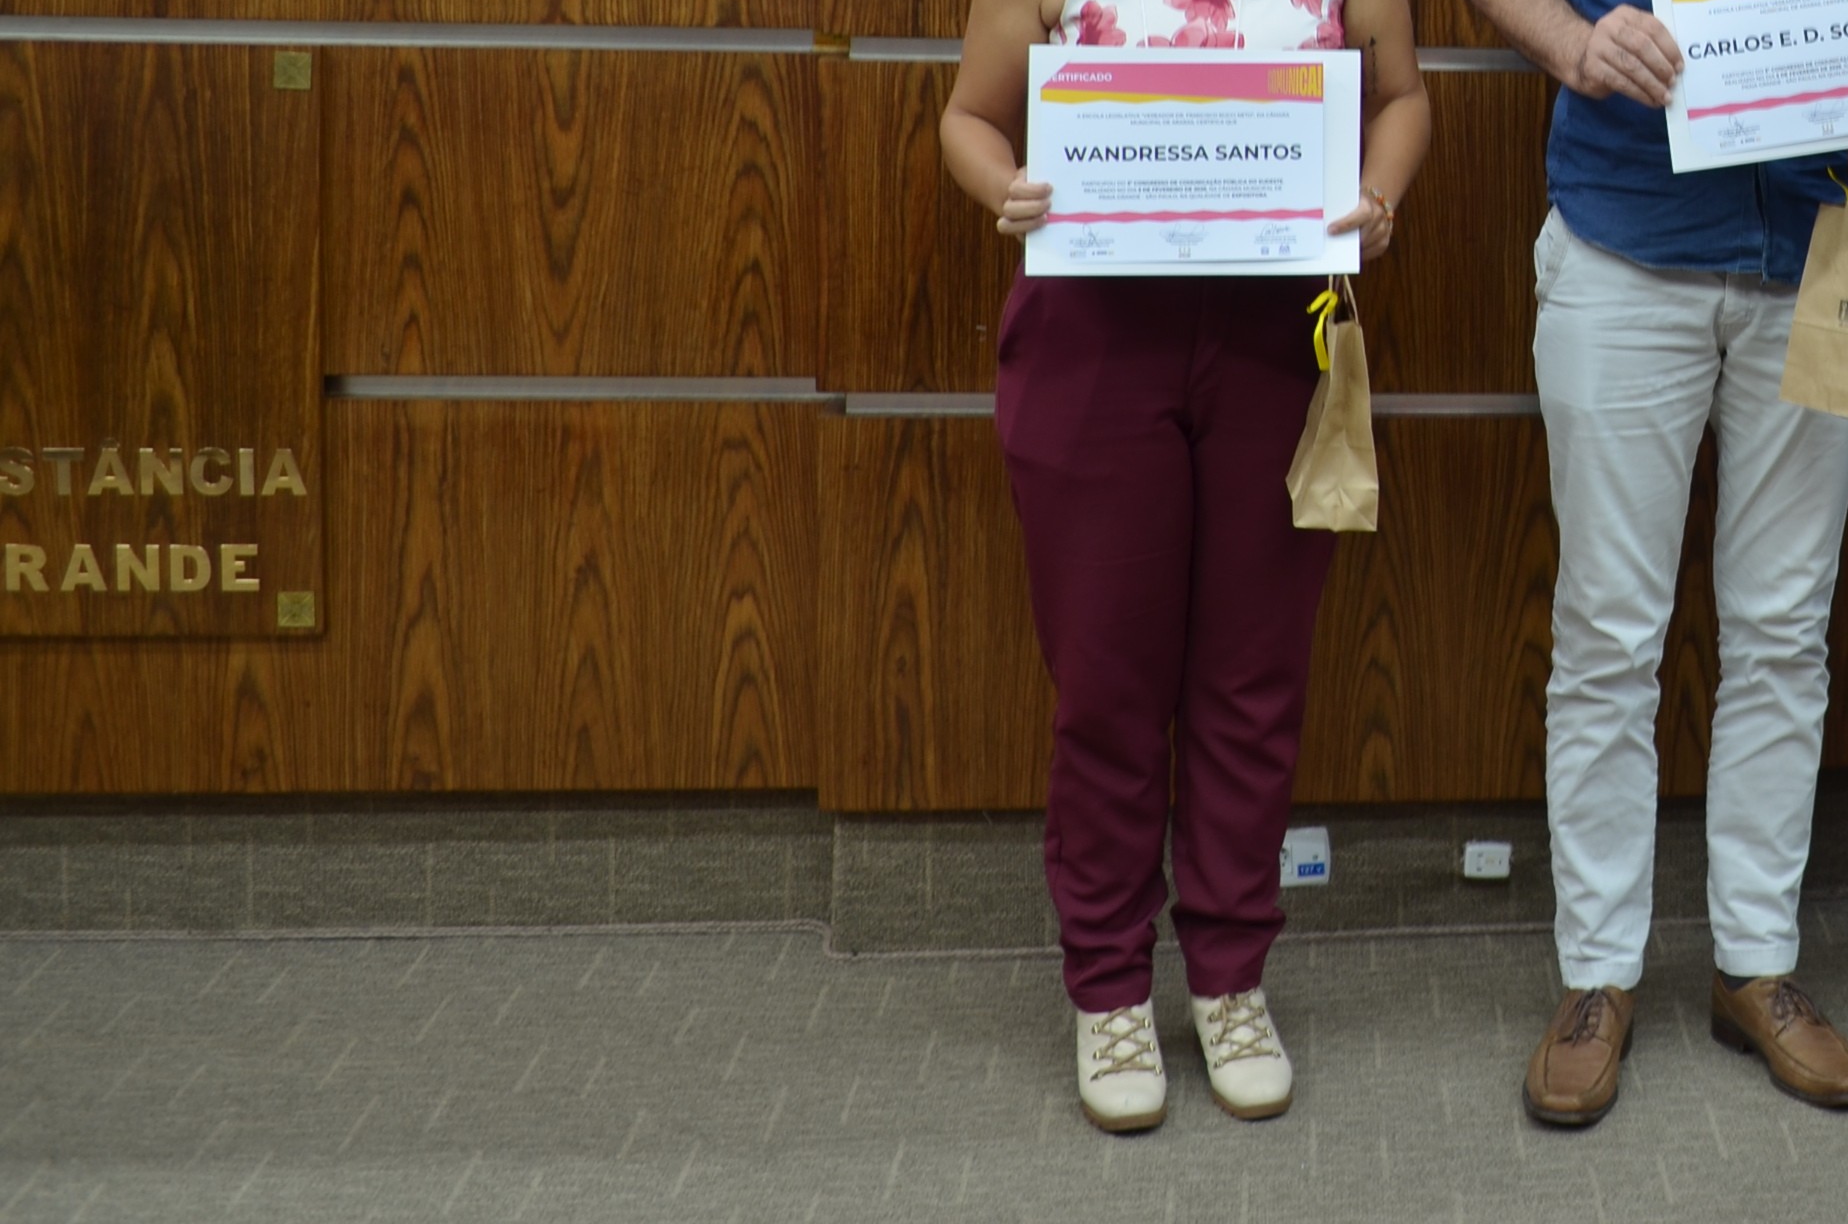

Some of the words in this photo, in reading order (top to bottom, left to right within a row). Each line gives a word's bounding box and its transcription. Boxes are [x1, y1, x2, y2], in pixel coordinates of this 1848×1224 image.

[1688, 33, 1773, 60] CARLOS
[1780, 30, 1798, 47] E.
[1804, 27, 1825, 44] D.
[1052, 72, 1113, 83] ERTIFICADO
[1064, 145, 1208, 163] WANDRESSA
[1215, 143, 1302, 161] SANTOS
[5, 543, 260, 592] RANDE
